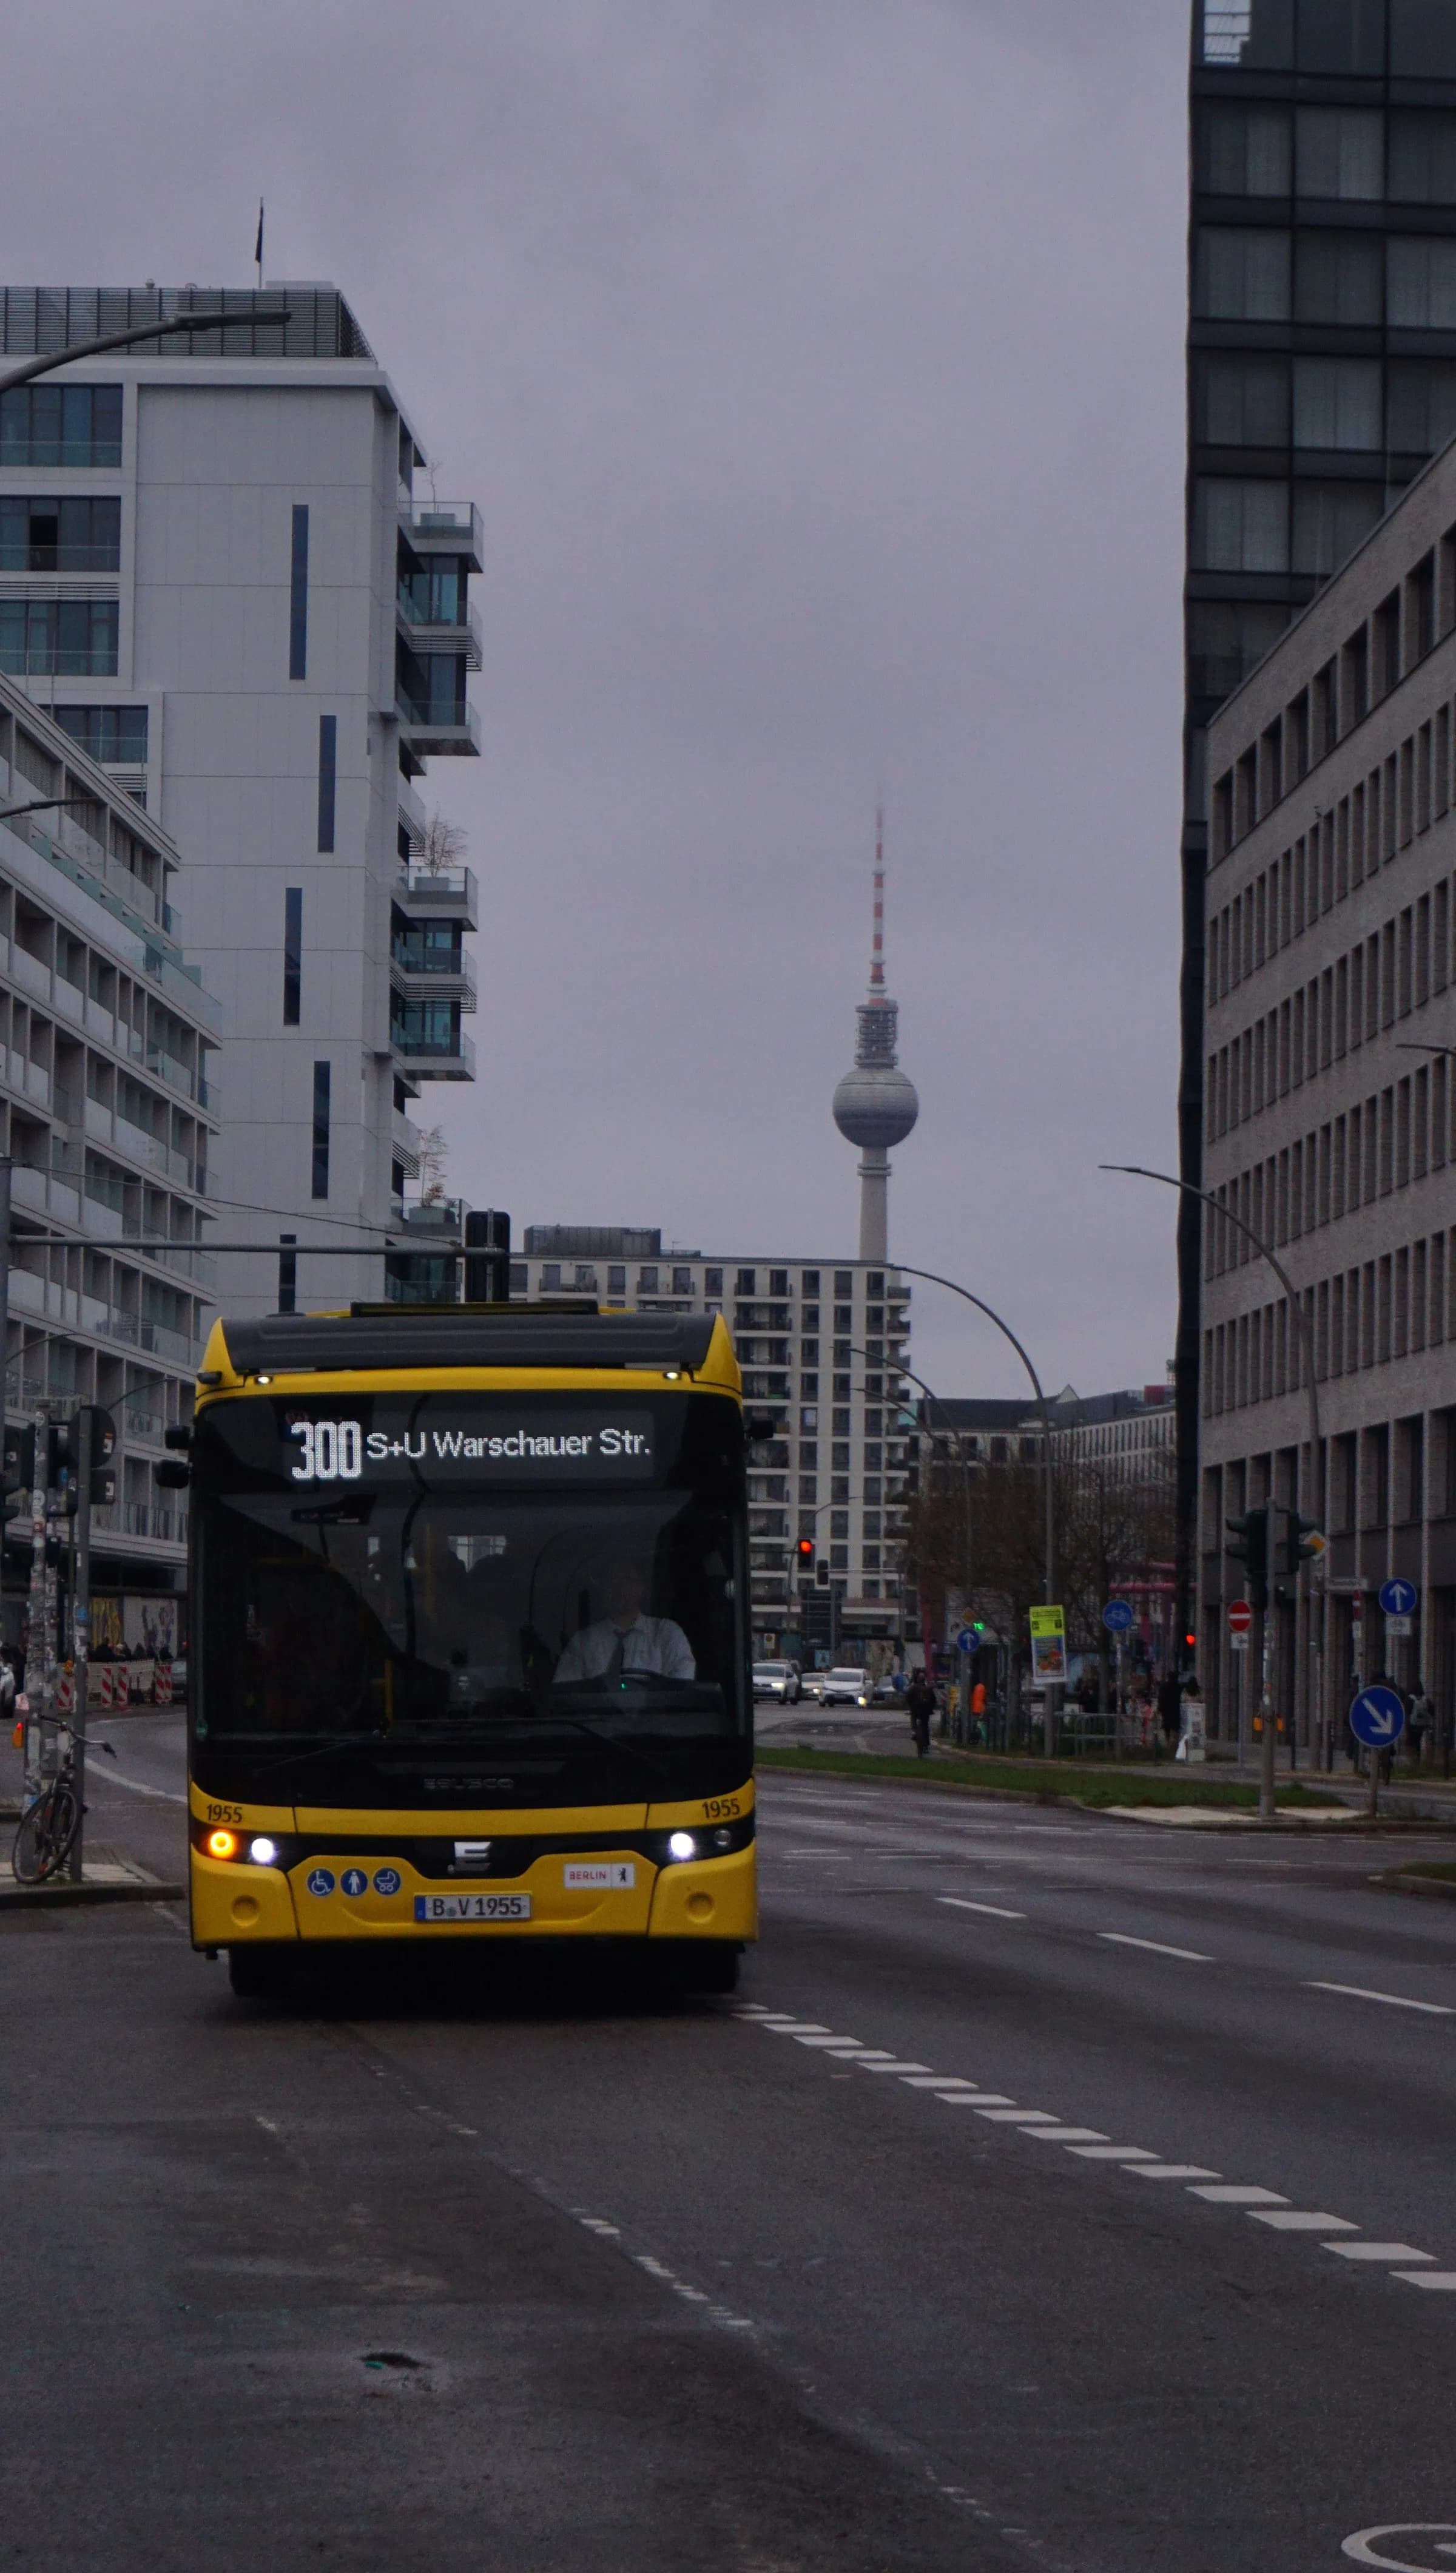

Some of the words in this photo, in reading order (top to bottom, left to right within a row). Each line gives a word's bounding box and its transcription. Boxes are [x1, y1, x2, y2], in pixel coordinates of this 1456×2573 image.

[291, 1421, 363, 1479] 300
[366, 1432, 426, 1458] S+U
[433, 1430, 592, 1457] Warschauer
[599, 1429, 651, 1455] Str.
[206, 1804, 243, 1824] 1955
[702, 1798, 740, 1818] 1955
[570, 1871, 606, 1880] BERLIN
[433, 1898, 445, 1916] B
[458, 1898, 470, 1916] V
[475, 1897, 522, 1916] 1955
